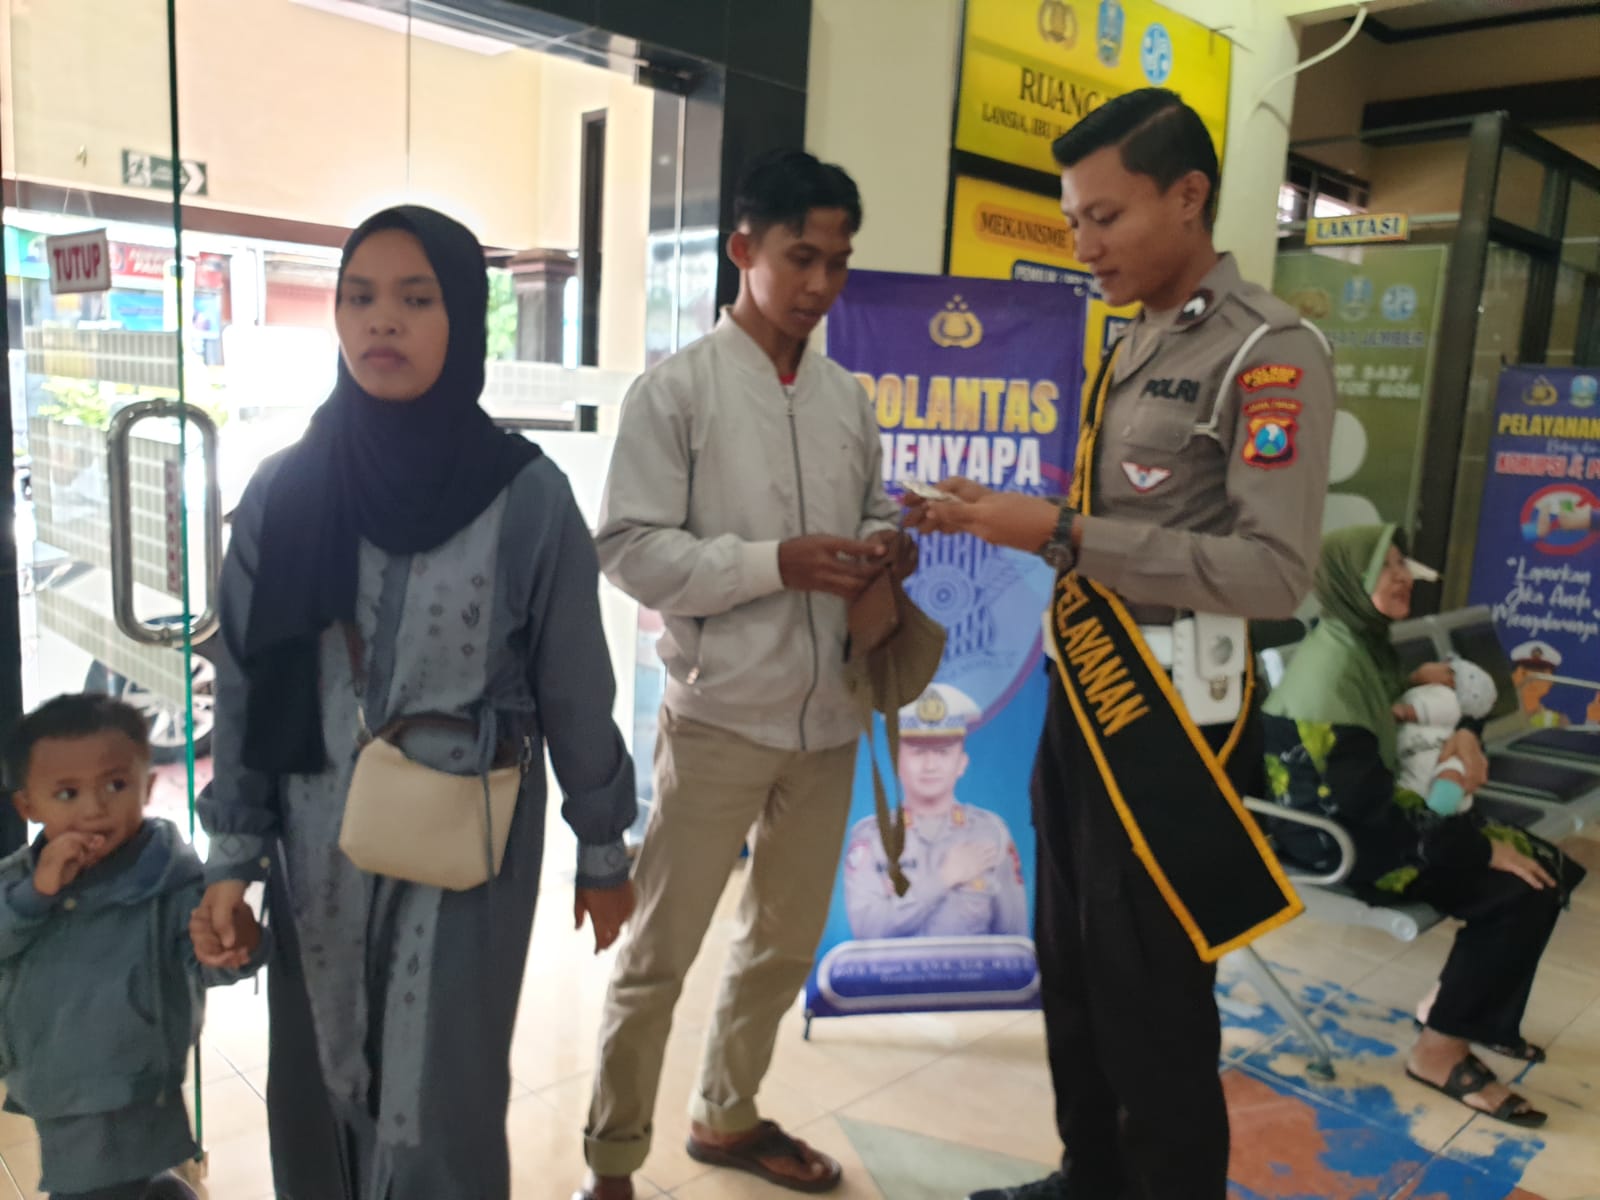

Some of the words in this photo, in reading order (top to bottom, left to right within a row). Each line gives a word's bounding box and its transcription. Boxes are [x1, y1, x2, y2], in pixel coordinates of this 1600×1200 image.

[1317, 216, 1399, 238] LAKTASI
[53, 243, 100, 281] TUTUP
[1141, 378, 1200, 402] POLRI
